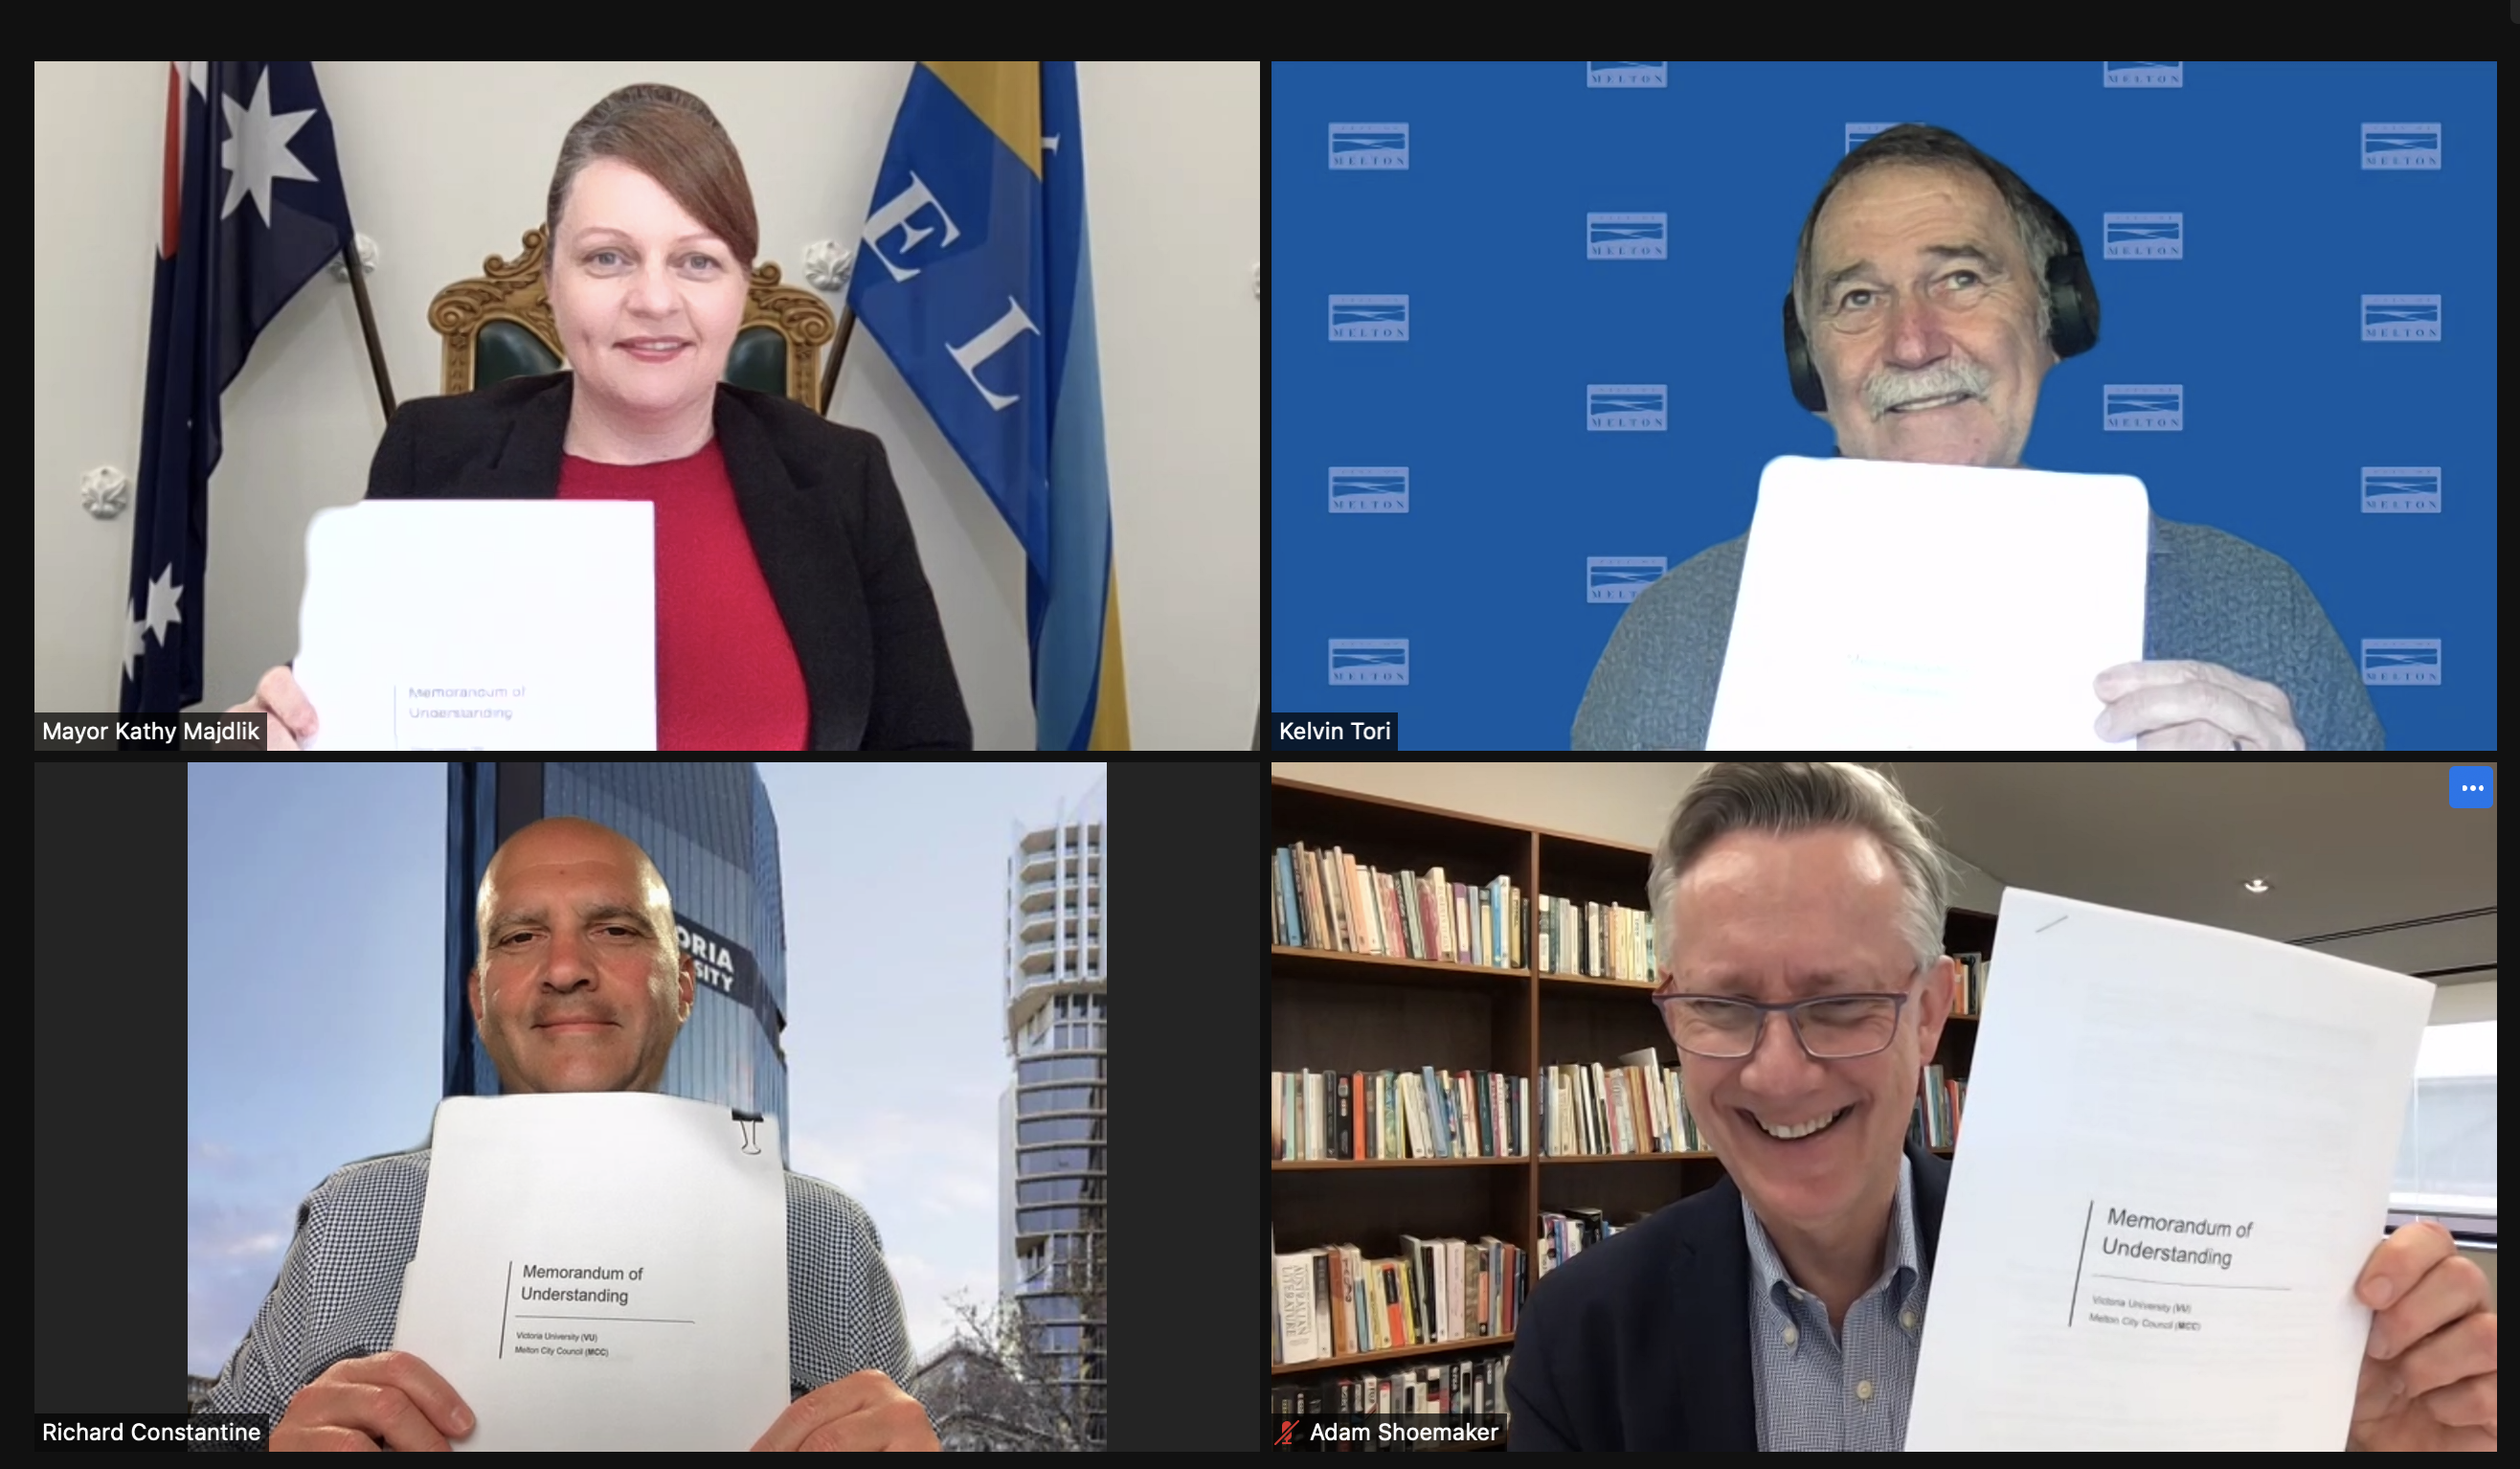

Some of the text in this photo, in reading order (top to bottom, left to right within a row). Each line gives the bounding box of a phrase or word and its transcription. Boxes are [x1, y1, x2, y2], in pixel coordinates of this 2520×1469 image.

[1591, 75, 1663, 84] MELTON
[2108, 75, 2178, 84] MELTON
[1333, 156, 1405, 166] MELTON
[2366, 156, 2437, 166] MELTON
[1591, 246, 1663, 256] MELTON
[2108, 246, 2178, 256] MELTON
[1333, 328, 1405, 338] MELTON
[2366, 328, 2437, 338] MELTON
[1591, 418, 1663, 427] MELTON
[2108, 418, 2179, 427] MELTON
[1333, 500, 1405, 509] MELTON
[2366, 500, 2437, 509] MELTON
[1333, 672, 1405, 682] MELTON
[2366, 672, 2437, 682] MELTON
[409, 707, 513, 721] Understanding
[2107, 1207, 2254, 1238] Memorandum of
[2102, 1236, 2233, 1270] Understanding
[523, 1264, 644, 1281] Memorandum of
[521, 1286, 628, 1306] Understanding
[2092, 1295, 2126, 1308] Victoria
[2128, 1299, 2171, 1314] University
[2089, 1312, 2120, 1324] Melton
[2121, 1316, 2139, 1328] City
[2142, 1319, 2173, 1331] Council
[516, 1331, 598, 1344] Victoria University (VU)
[515, 1345, 609, 1358] Melton City Council (MCC)
